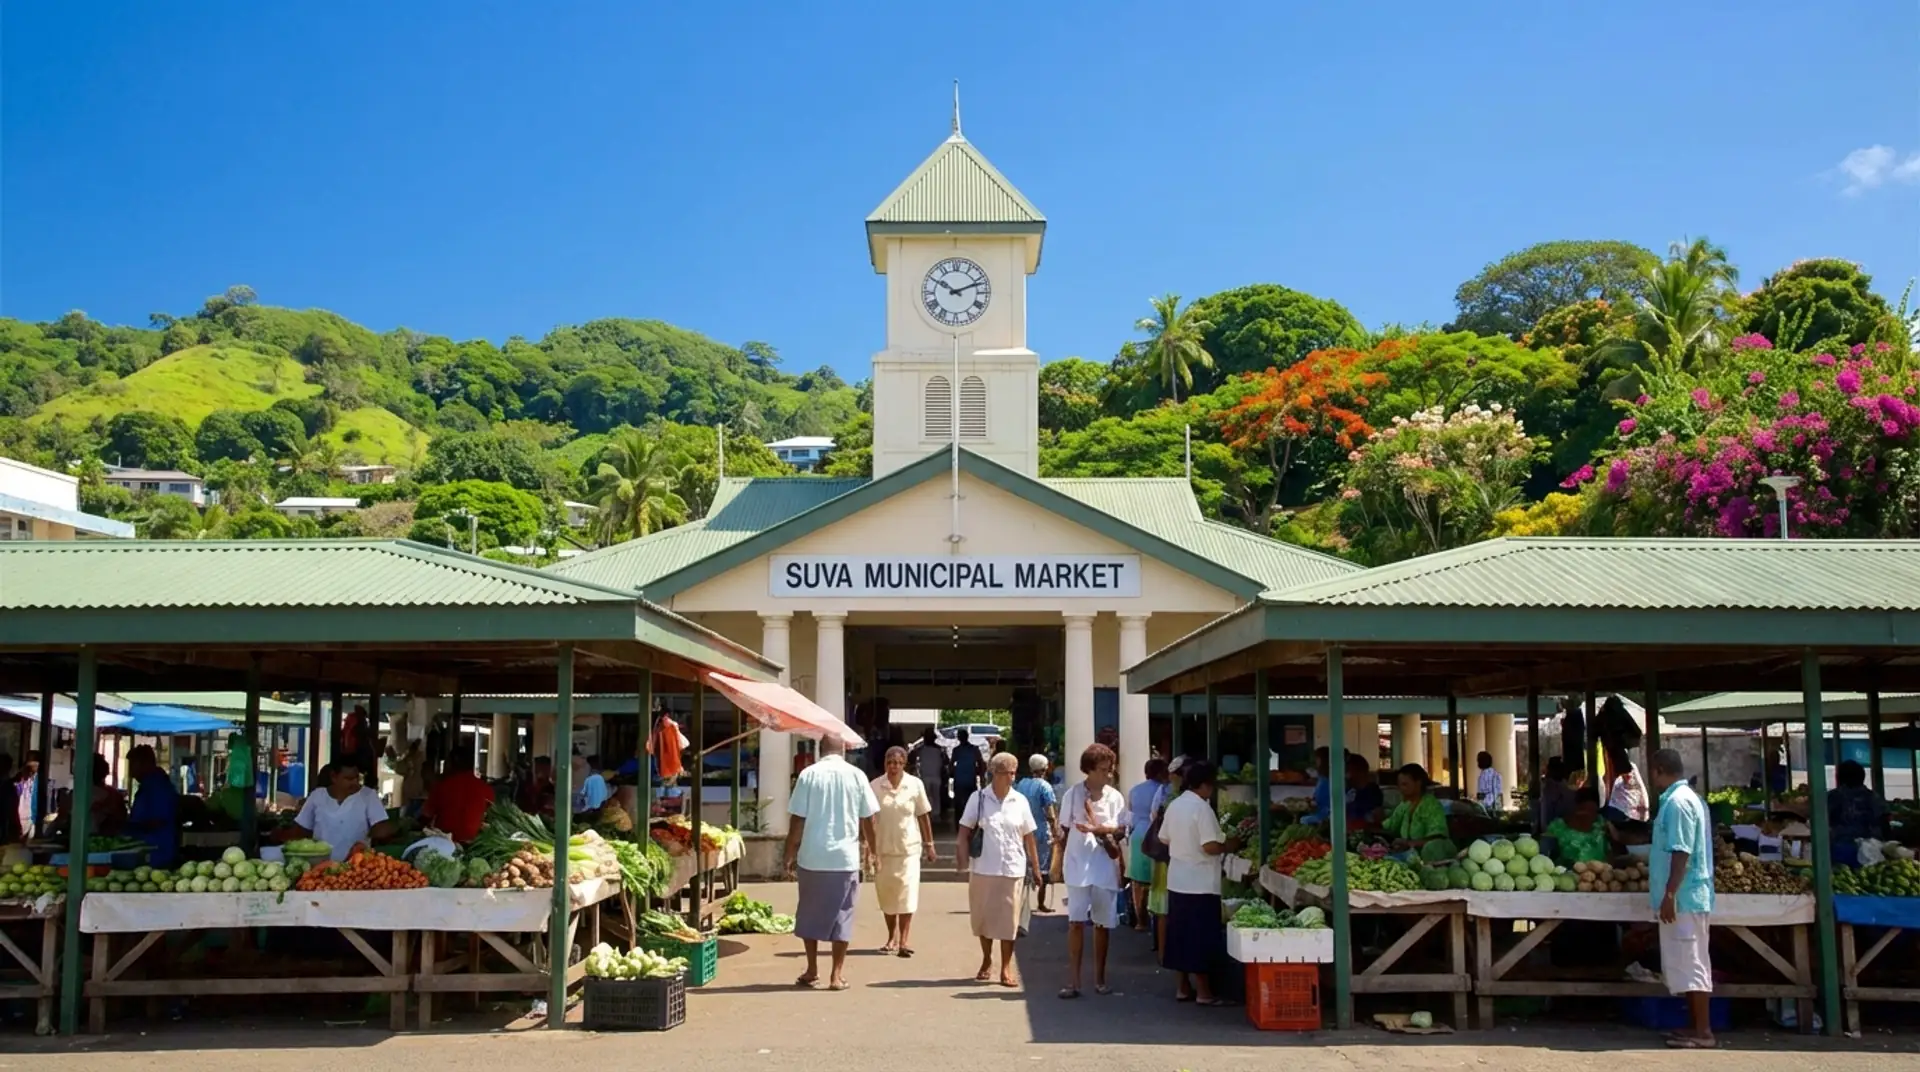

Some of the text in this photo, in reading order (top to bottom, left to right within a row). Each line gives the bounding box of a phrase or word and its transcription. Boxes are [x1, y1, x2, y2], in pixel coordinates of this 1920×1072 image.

[786, 562, 1124, 588] SUVA MUNICIPAL MARKET
